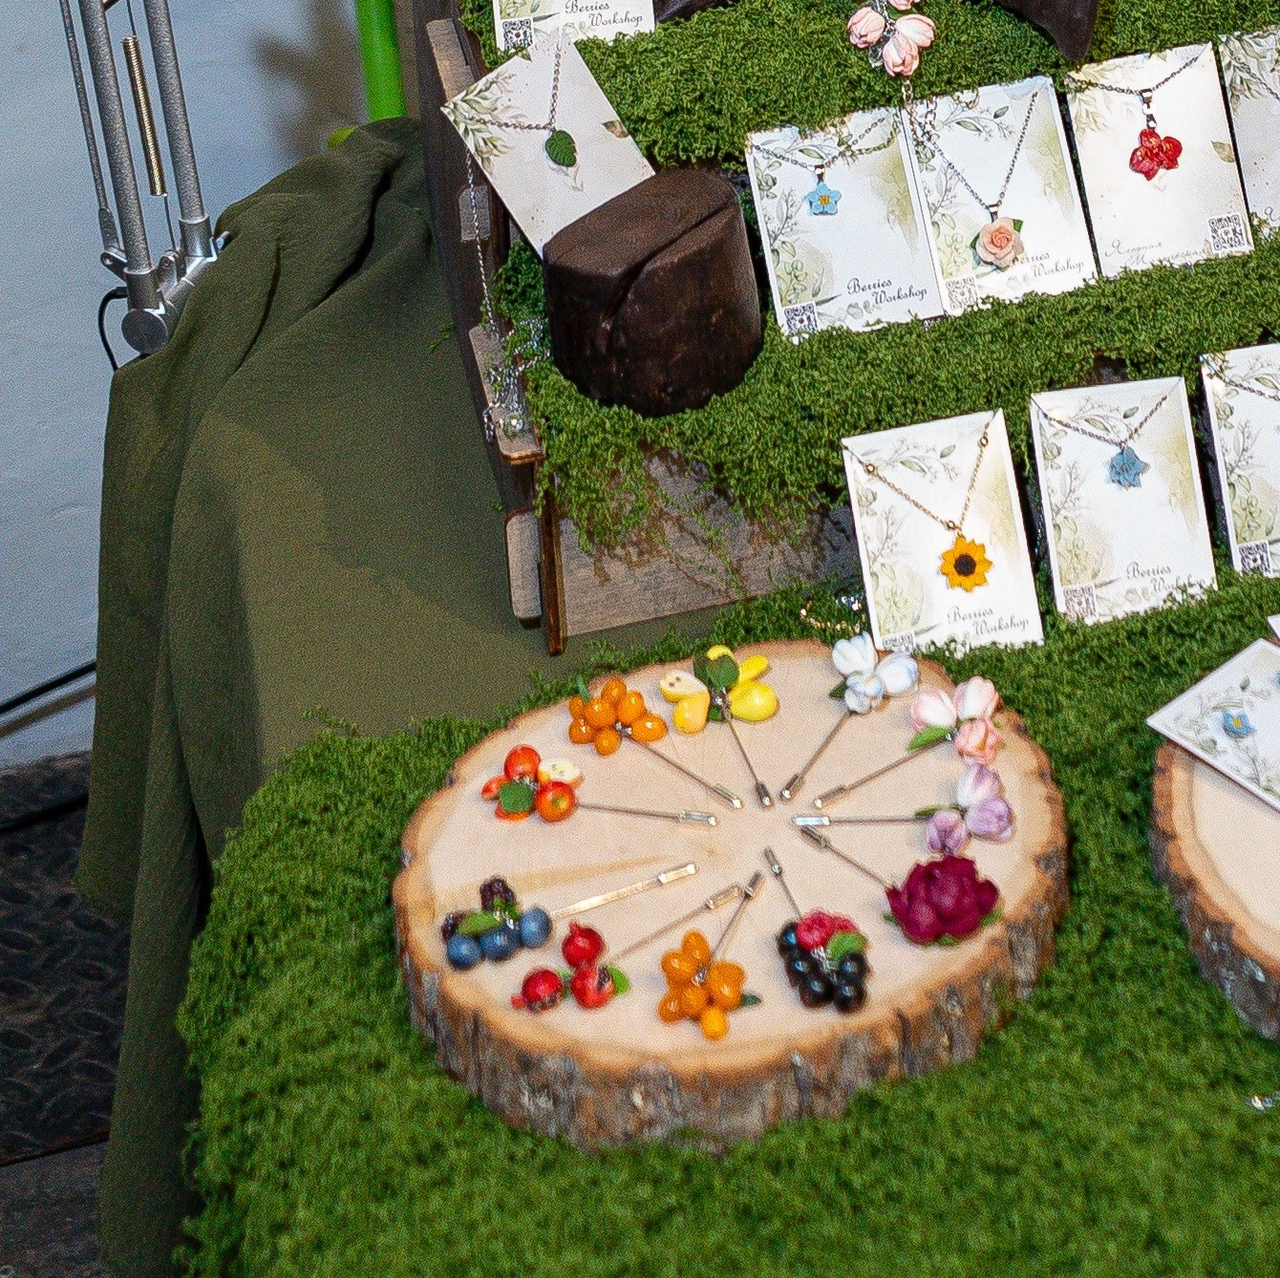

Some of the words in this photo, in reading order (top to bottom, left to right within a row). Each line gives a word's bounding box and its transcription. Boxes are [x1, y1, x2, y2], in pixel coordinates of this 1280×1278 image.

[588, 10, 643, 28] Workshop
[1031, 258, 1084, 278] Workshop
[847, 277, 892, 295] Berries
[871, 285, 928, 305] Workshop
[1126, 561, 1172, 580] Berries
[947, 605, 993, 624] Berries
[972, 614, 1029, 636] Workshop
